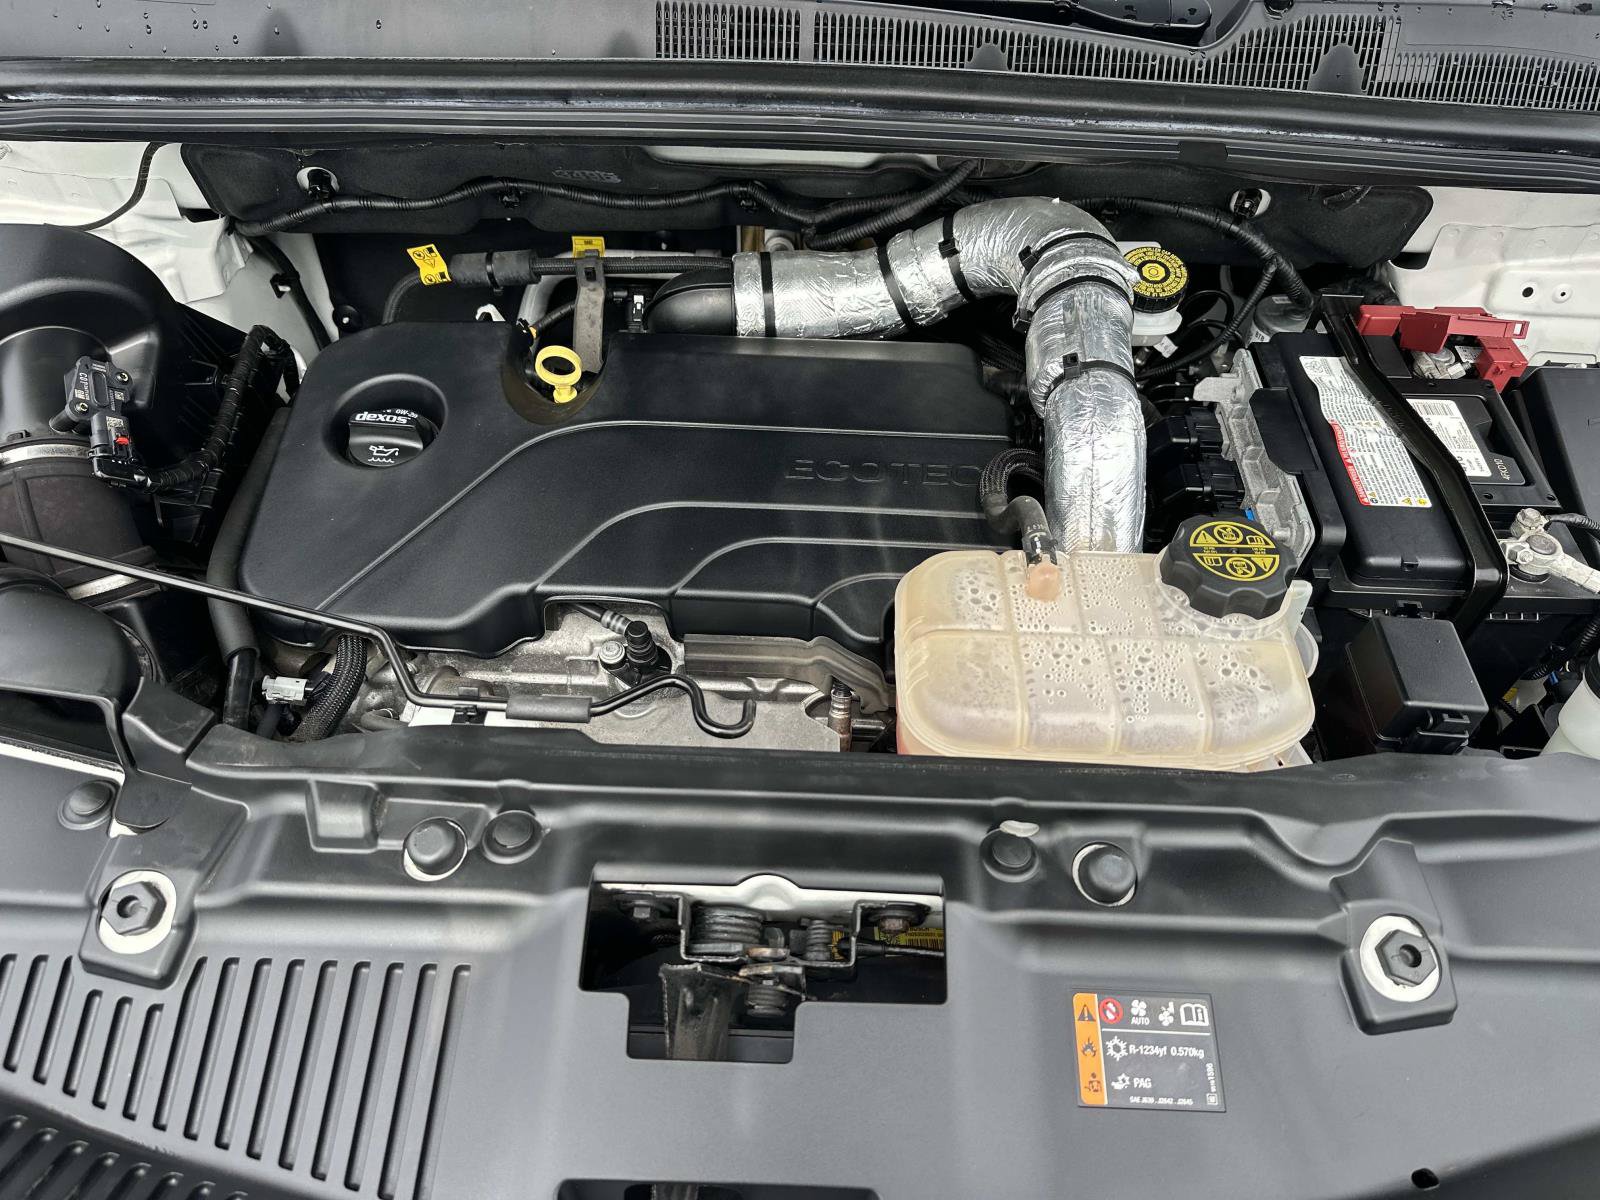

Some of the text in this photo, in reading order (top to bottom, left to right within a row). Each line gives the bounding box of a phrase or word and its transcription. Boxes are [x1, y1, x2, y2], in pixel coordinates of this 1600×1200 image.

[1131, 1016, 1150, 1025] AUTO
[1129, 1045, 1205, 1059] R-1234yf 0.570kg
[1133, 1077, 1152, 1088] PAG
